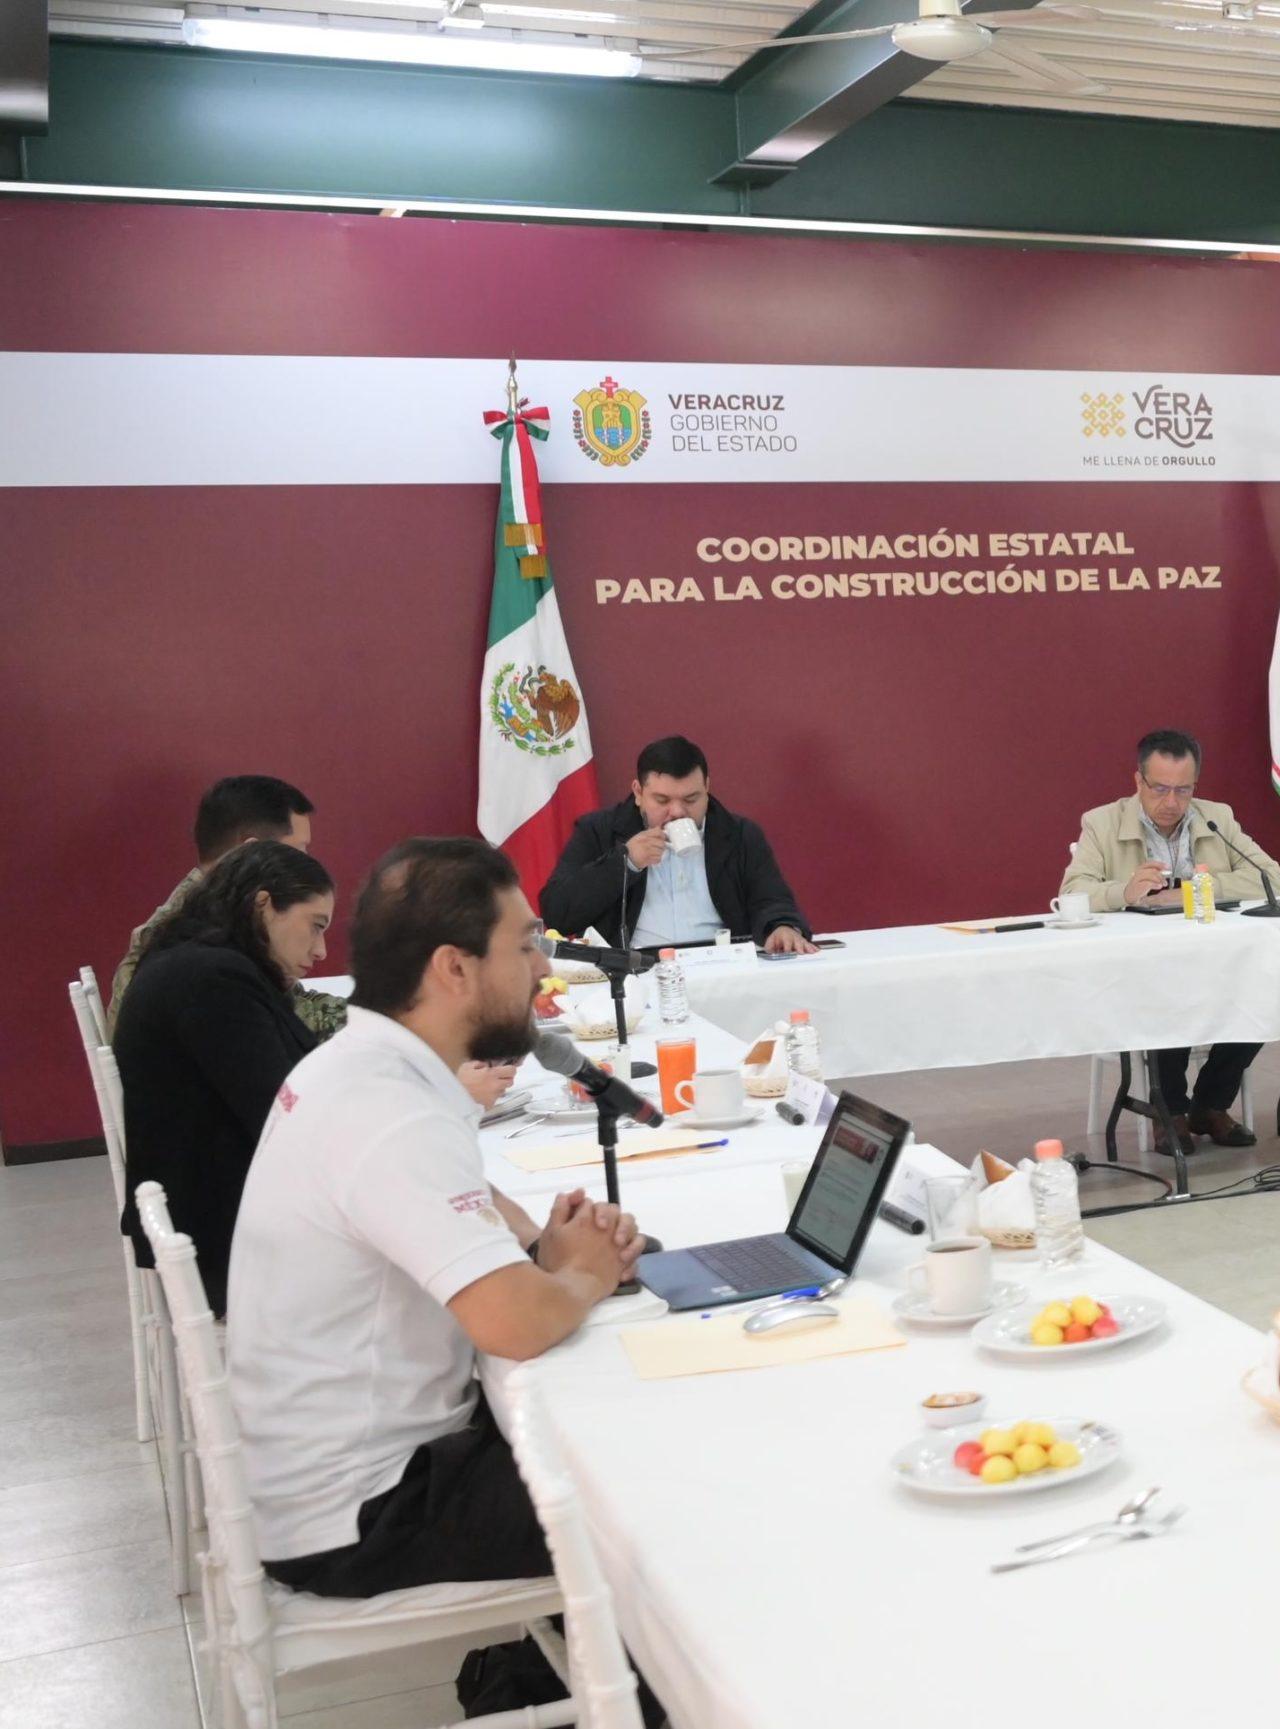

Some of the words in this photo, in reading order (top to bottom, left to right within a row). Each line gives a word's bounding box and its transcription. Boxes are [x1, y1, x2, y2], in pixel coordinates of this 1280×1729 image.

[668, 393, 785, 411] VERACRUZ
[1132, 384, 1213, 416] VERA
[670, 414, 778, 432] GOBIERNO
[1134, 417, 1213, 448] CRUZ
[672, 435, 713, 452] DEL
[717, 435, 798, 453] ESTADO
[1082, 456, 1099, 466] ME
[1104, 456, 1141, 466] LLENA
[1144, 456, 1159, 466] DE
[1162, 456, 1216, 466] ORGULLO
[697, 527, 980, 562] COORDINACIÓN
[989, 531, 1135, 556] ESTATAL
[595, 577, 705, 604] PARA
[713, 575, 763, 601] LA
[771, 563, 1047, 600] CONSTRUCCIÓN
[1055, 568, 1100, 592] DE
[1108, 567, 1151, 591] LA
[1158, 566, 1222, 590] PAZ
